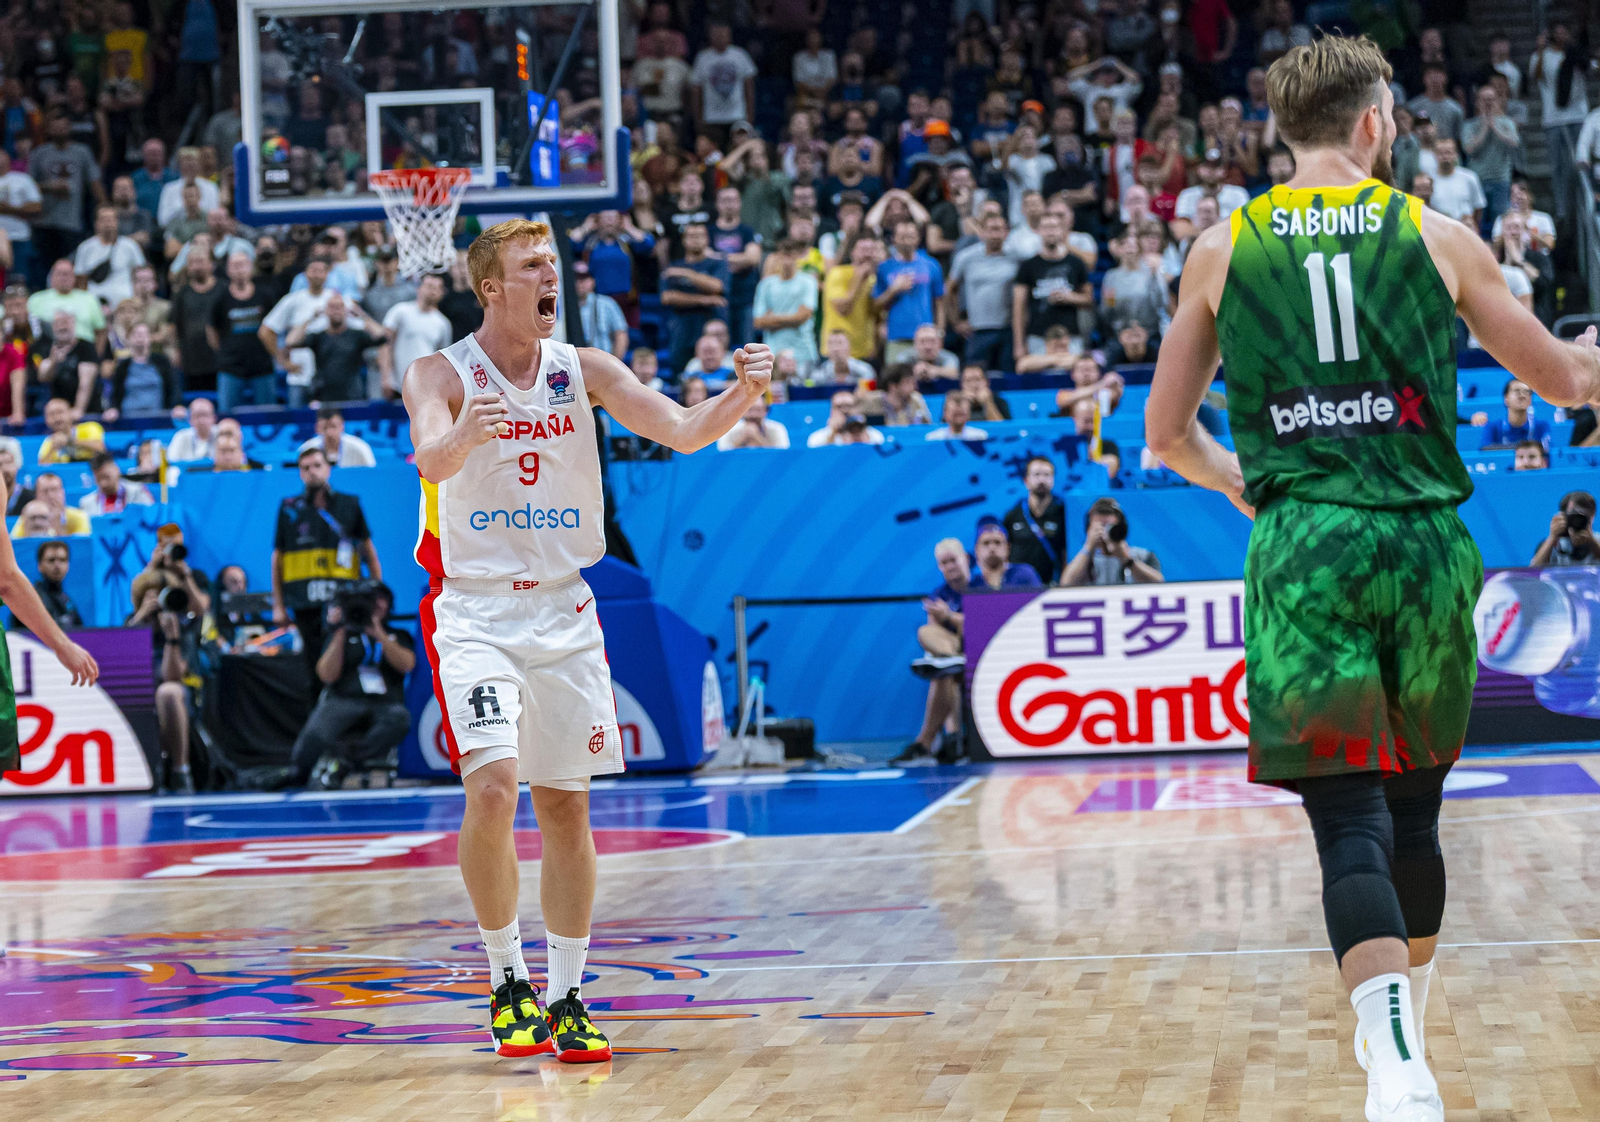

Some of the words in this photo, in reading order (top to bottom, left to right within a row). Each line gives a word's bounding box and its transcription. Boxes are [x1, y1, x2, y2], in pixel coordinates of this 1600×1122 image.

[1271, 203, 1383, 237] SABONIS
[1303, 253, 1360, 363] 11
[491, 413, 575, 440] SPAÑA
[1270, 391, 1394, 436] betsafe
[518, 452, 540, 486] 9
[469, 502, 580, 531] endesa
[513, 580, 539, 590] ESP
[1042, 596, 1246, 660] 百岁山
[467, 685, 502, 719] fi
[998, 656, 1249, 748] Gant
[468, 717, 511, 729] network
